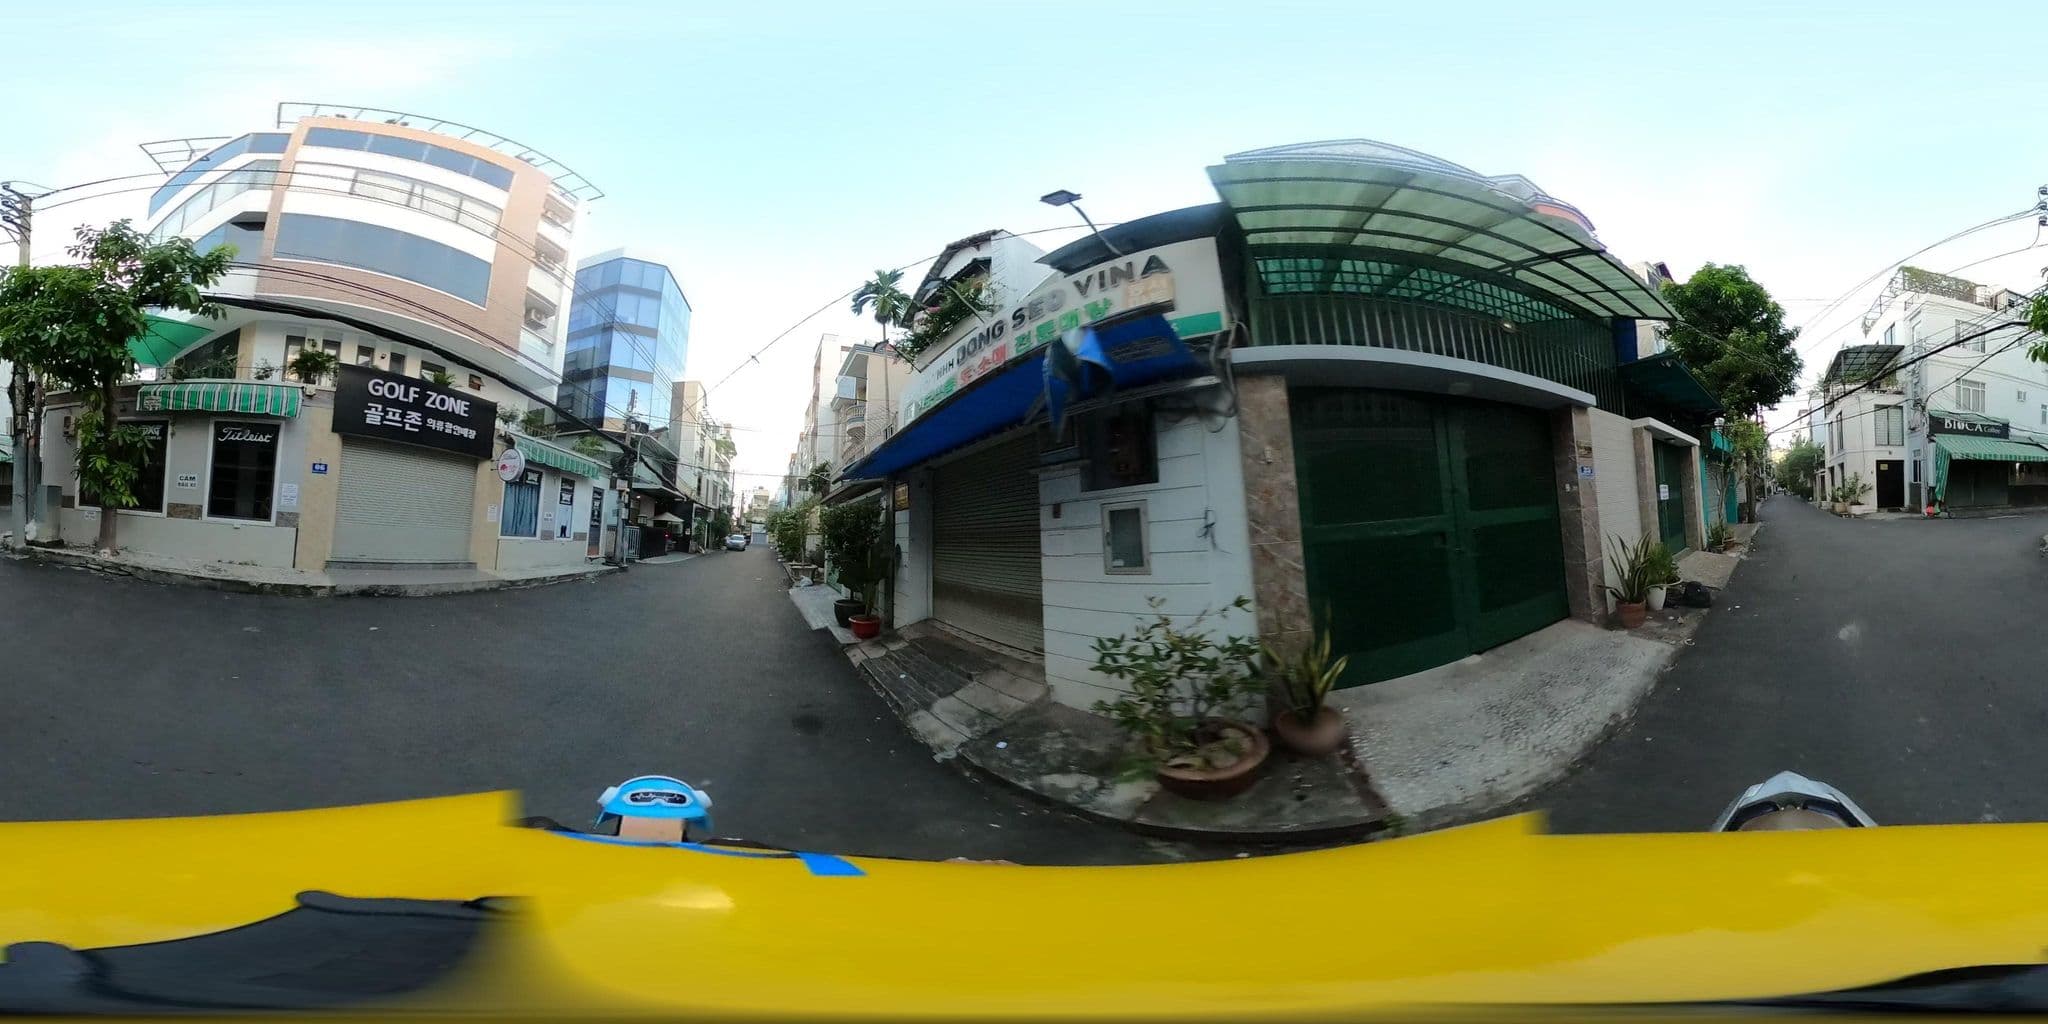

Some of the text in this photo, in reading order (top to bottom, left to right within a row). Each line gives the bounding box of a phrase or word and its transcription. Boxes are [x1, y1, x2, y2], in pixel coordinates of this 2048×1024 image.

[957, 317, 1006, 366] DONG
[1012, 288, 1067, 330] SEO
[1073, 254, 1169, 299] VINA
[367, 378, 471, 417] GOLF ZONE
[364, 403, 422, 432] 골프존
[218, 427, 273, 443] Titleist
